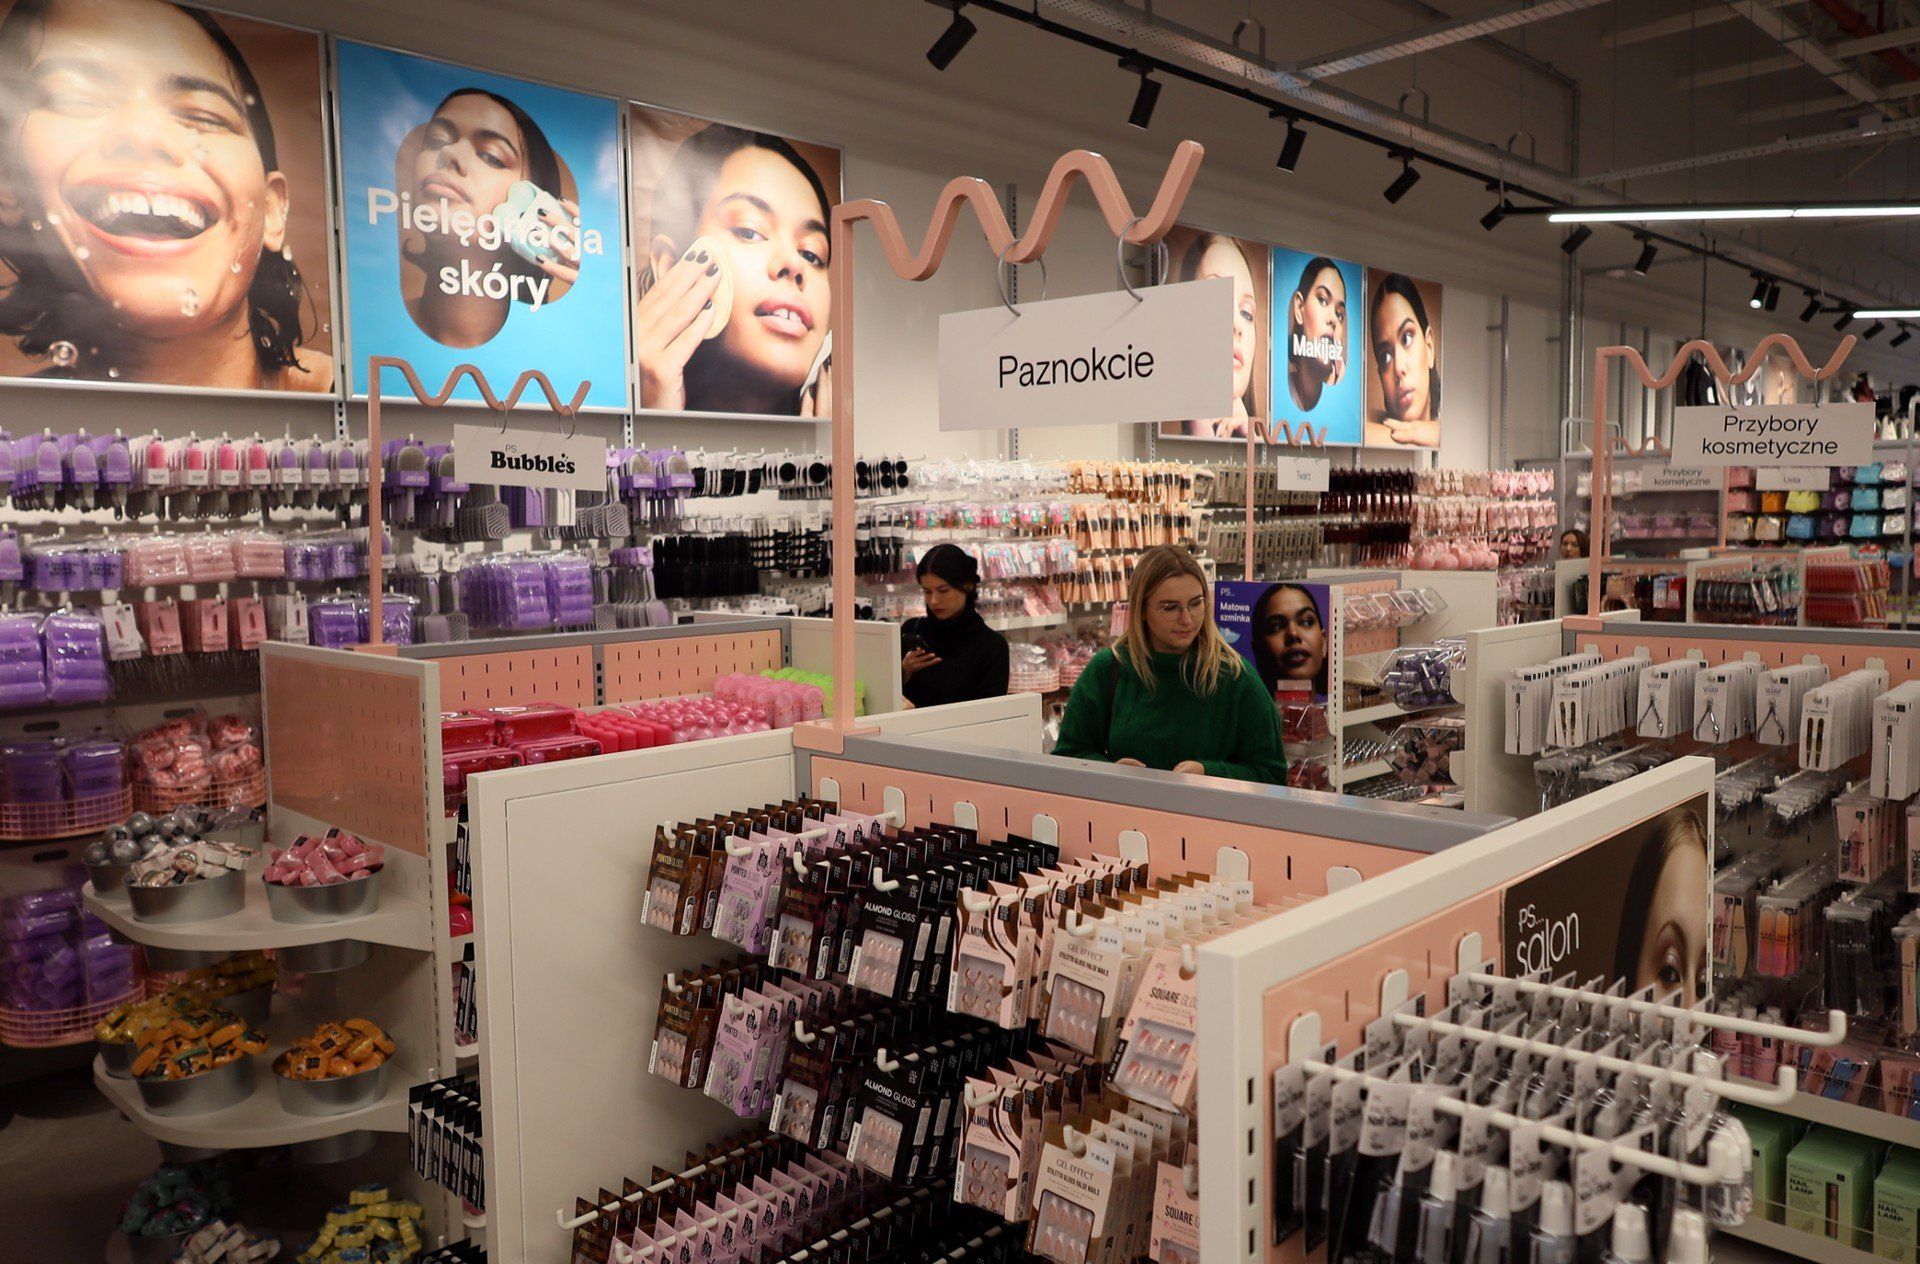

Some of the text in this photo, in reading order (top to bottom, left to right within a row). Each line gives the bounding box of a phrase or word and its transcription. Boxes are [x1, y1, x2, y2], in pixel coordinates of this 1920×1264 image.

[367, 187, 603, 261] Pielęgnacja
[438, 259, 550, 312] skóry
[1293, 333, 1343, 364] Makijaż
[999, 344, 1154, 388] Paznokcie
[1723, 415, 1819, 436] Przybory
[1702, 438, 1838, 458] kosmetyczne
[1654, 478, 1711, 486] kosmetyczne
[1662, 467, 1703, 478] Przybory
[1220, 602, 1250, 612] Matowa
[1219, 614, 1251, 623] szminka
[730, 864, 747, 878] POINTED
[864, 901, 917, 923] ALMOND GLOSS
[1067, 943, 1104, 962] GEL EFFECT
[1516, 912, 1580, 977] salon
[1149, 987, 1198, 1010] SQUARE GLO
[864, 1078, 893, 1097] ALMOND
[893, 1091, 917, 1109] GLOSS
[1367, 1116, 1407, 1128] Nail Glue
[1056, 1158, 1094, 1180] GEL EFFECT
[1789, 1178, 1808, 1189] NAIL
[1789, 1185, 1814, 1195] LAMP
[1164, 1205, 1193, 1226] SQUARE
[1877, 1204, 1899, 1214] NAIL
[1877, 1211, 1904, 1222] LAMP
